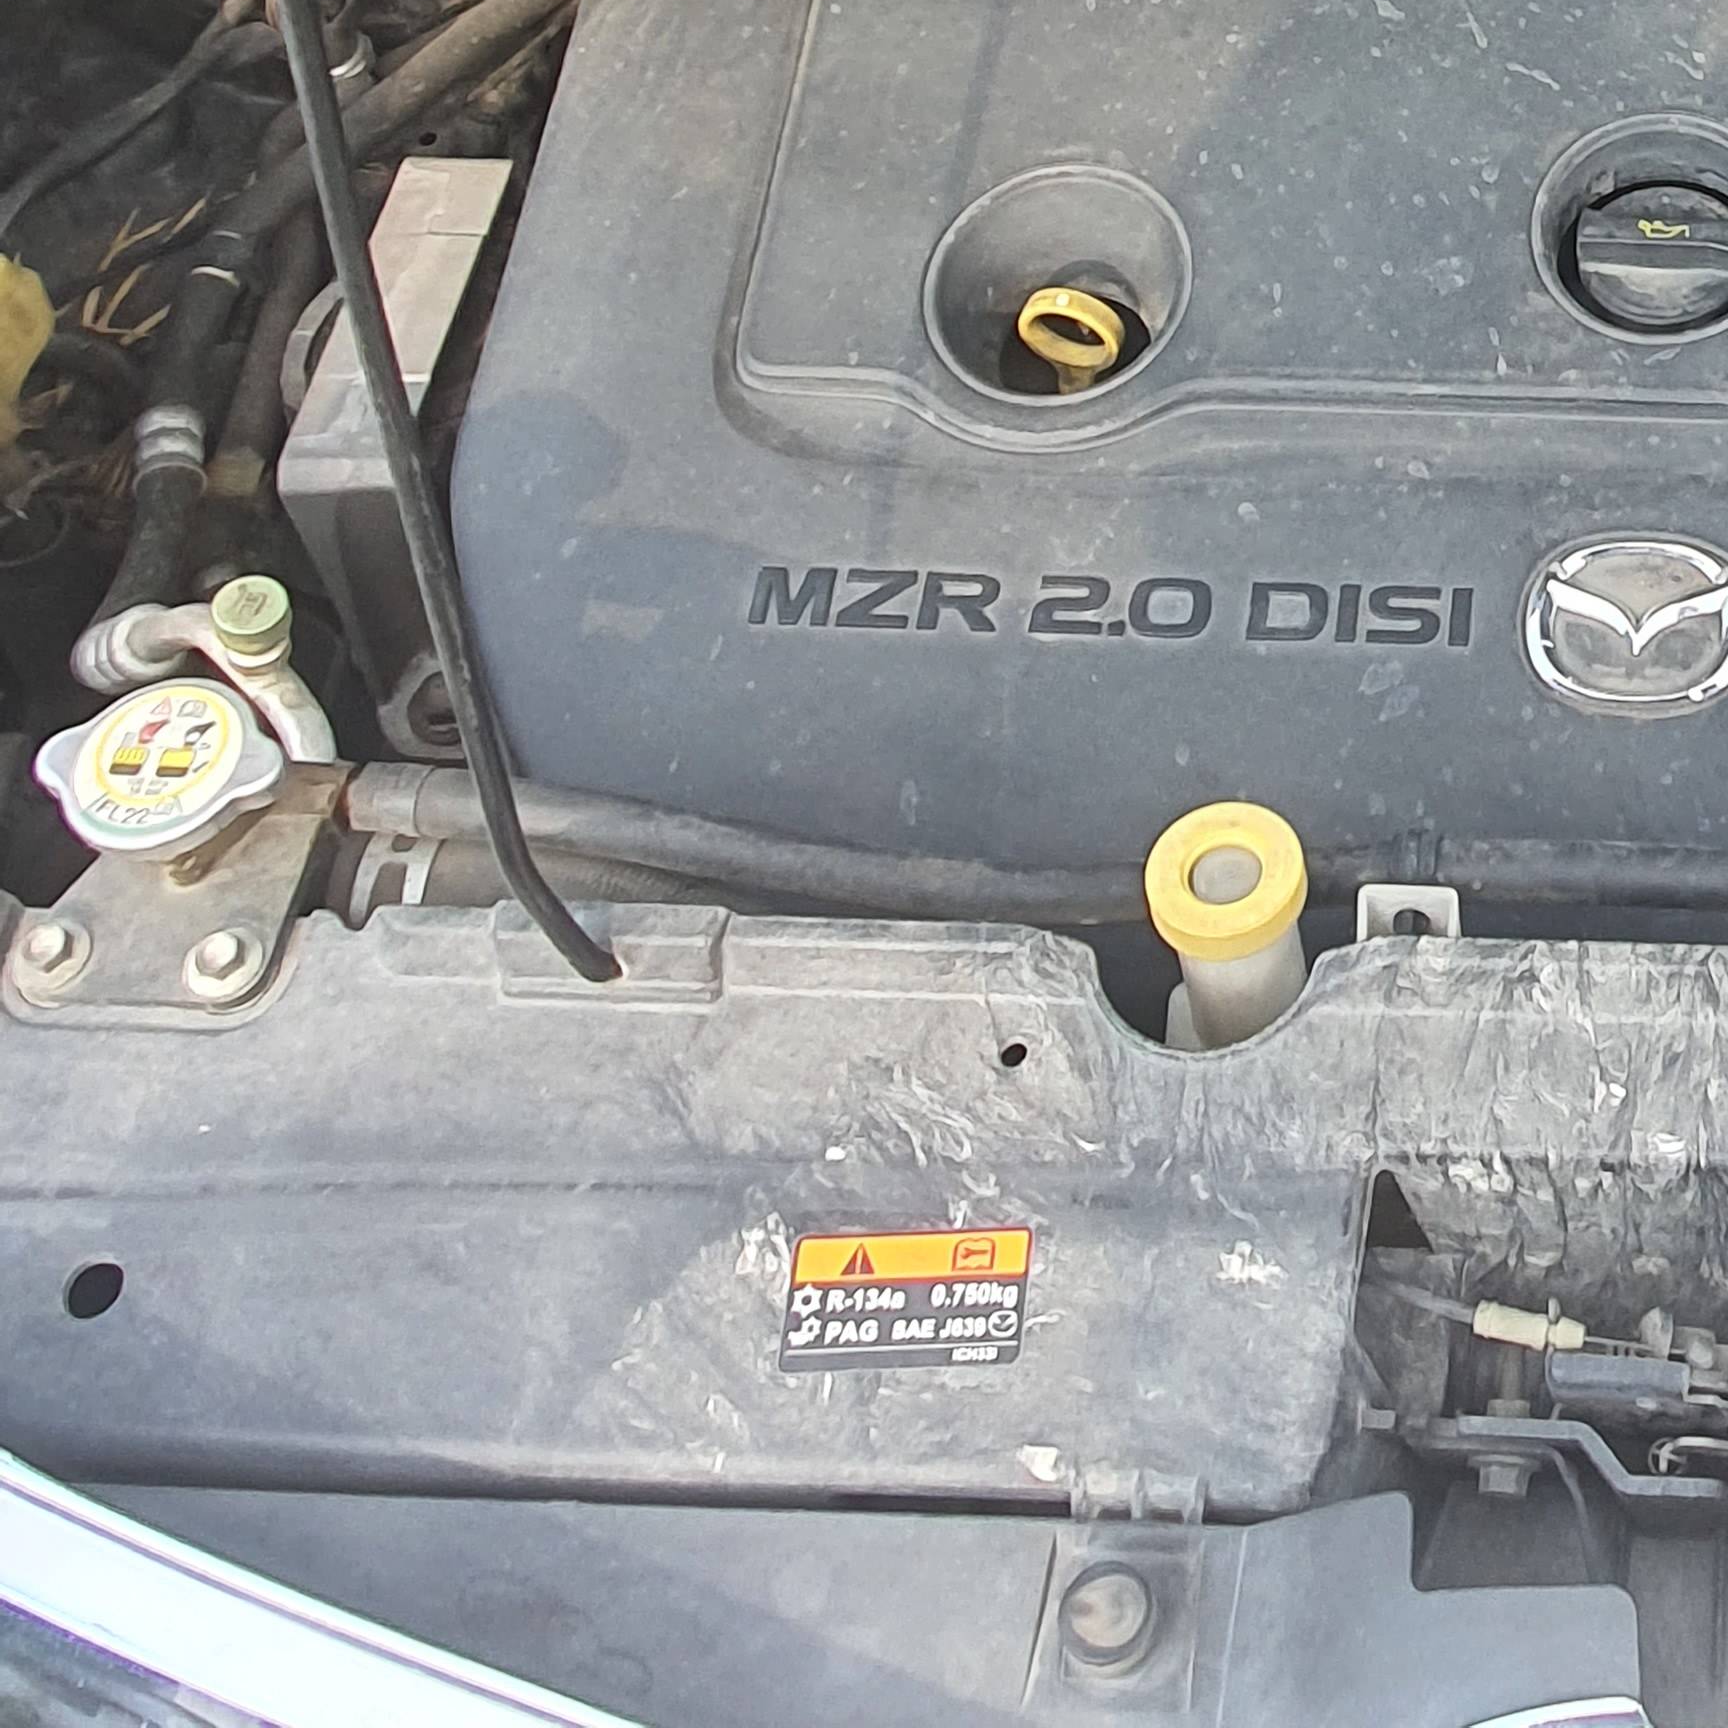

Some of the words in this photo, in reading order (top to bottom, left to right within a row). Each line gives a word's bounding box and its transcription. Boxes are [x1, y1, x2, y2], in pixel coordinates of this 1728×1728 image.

[747, 566, 1000, 633] MZR
[1028, 575, 1211, 639] 2.0
[1245, 581, 1474, 647] DISI
[95, 798, 151, 825] FL22
[825, 1286, 906, 1313] R-134a
[823, 1319, 880, 1345] PAG
[892, 1318, 936, 1340] SAE
